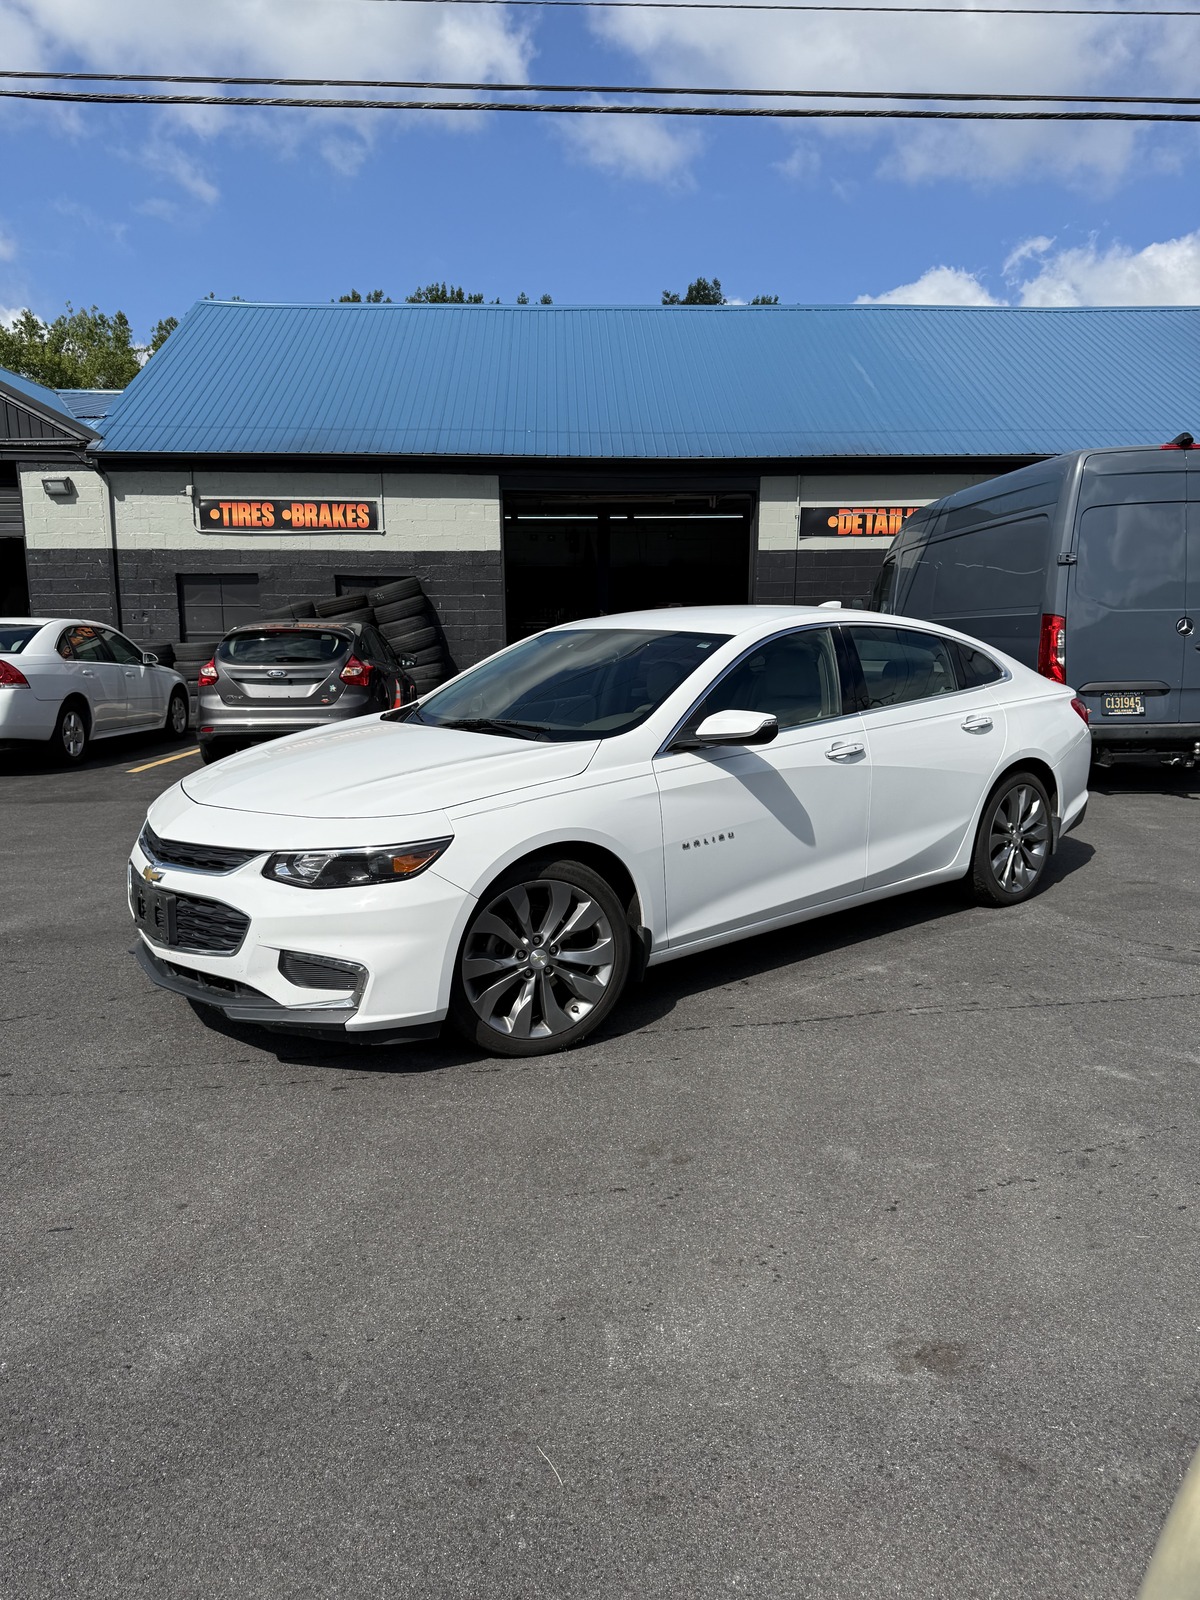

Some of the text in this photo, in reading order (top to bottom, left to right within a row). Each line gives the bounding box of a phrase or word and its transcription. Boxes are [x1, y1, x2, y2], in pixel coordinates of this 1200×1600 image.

[219, 502, 370, 529] TIRES BRAKES
[838, 508, 920, 535] DETAIL
[1105, 697, 1141, 709] C131945
[682, 832, 735, 850] MALIBU
